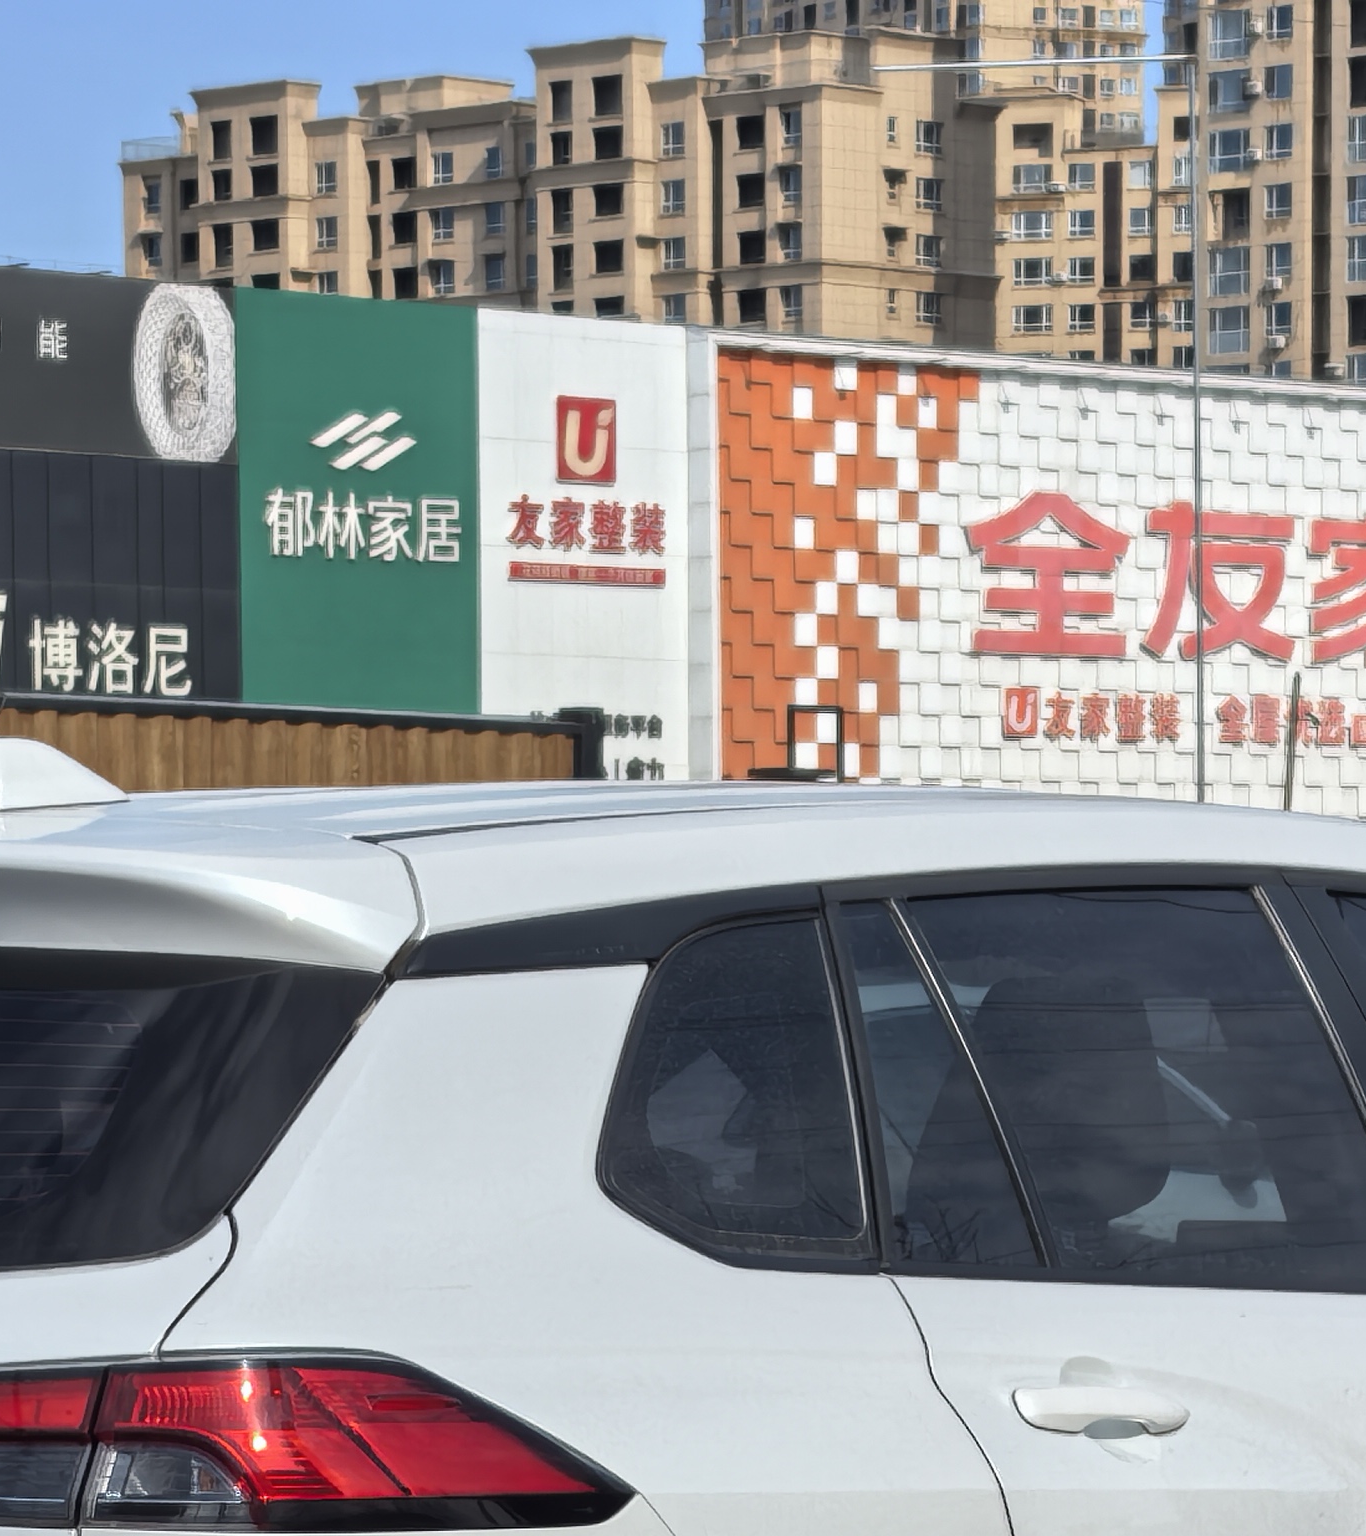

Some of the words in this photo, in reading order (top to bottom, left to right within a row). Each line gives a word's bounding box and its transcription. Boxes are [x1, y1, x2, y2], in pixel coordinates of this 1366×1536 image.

[265, 489, 461, 562] 郁林家居
[507, 495, 666, 556] 友家整装
[29, 617, 192, 697] 博洛尼
